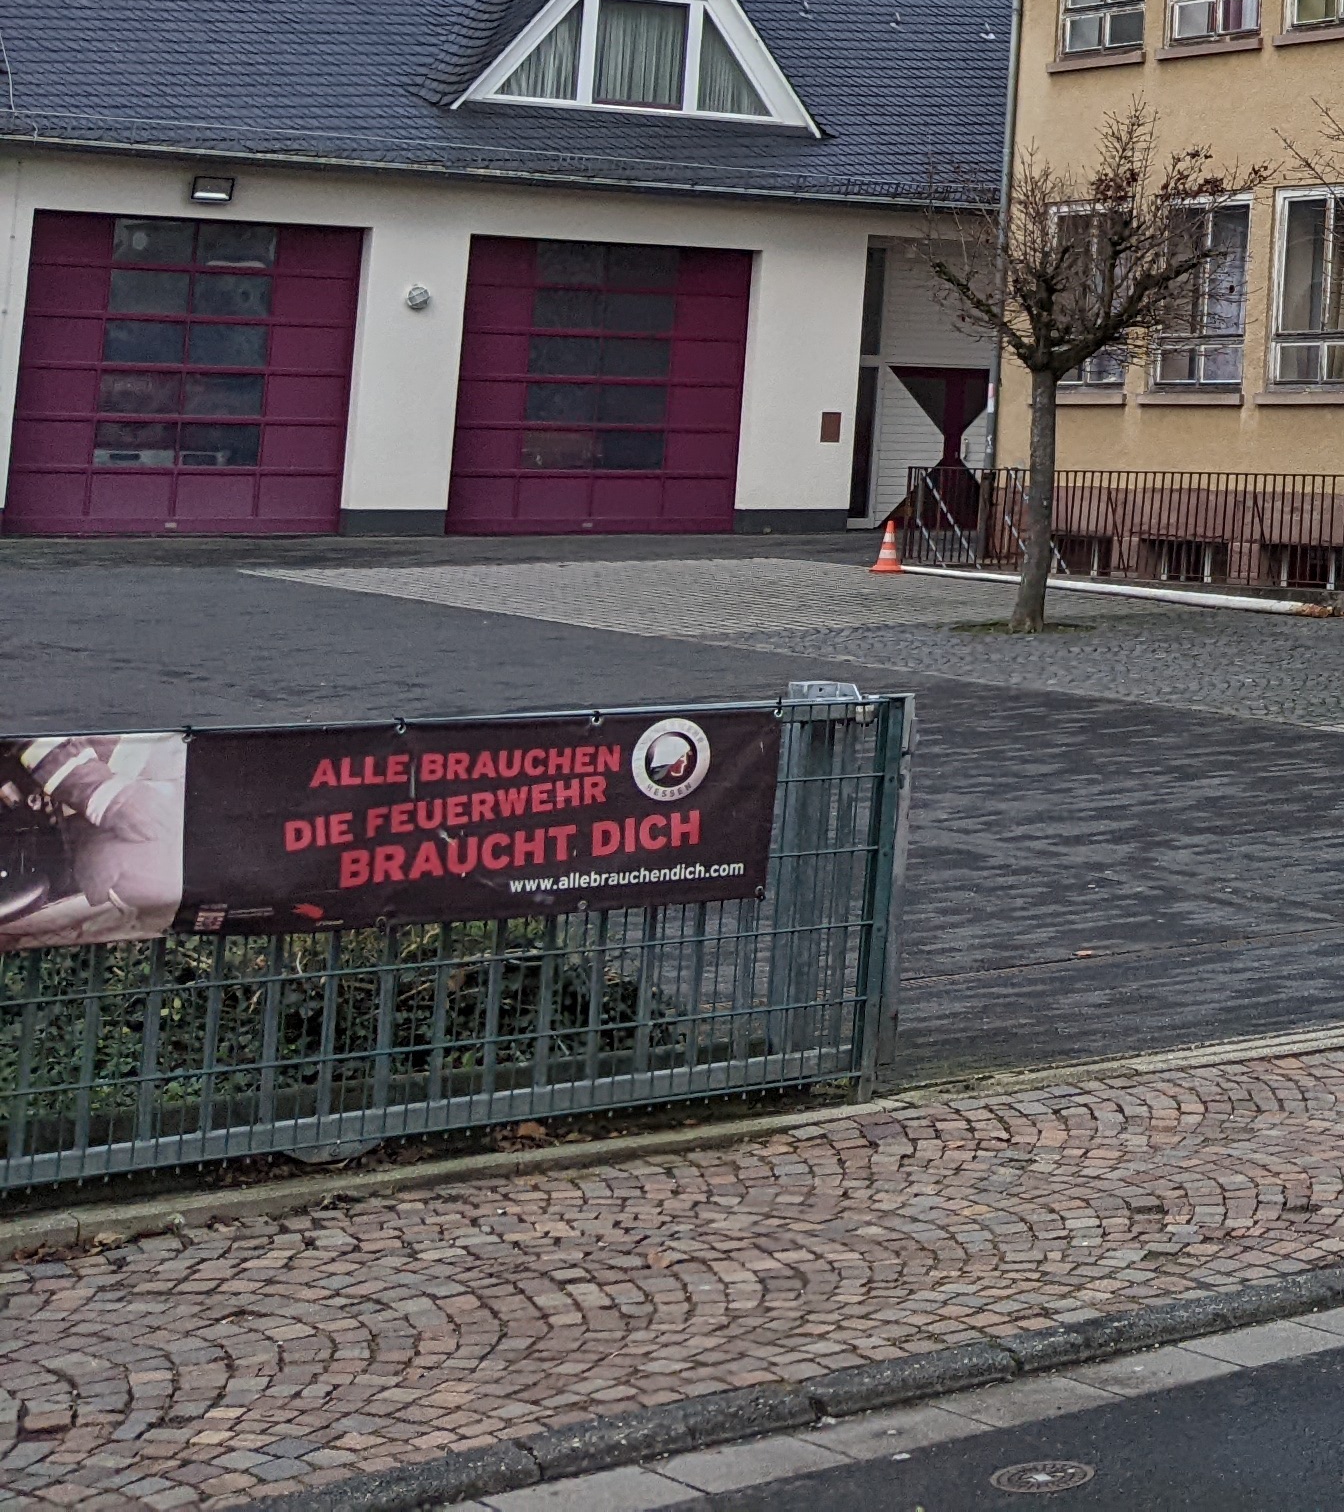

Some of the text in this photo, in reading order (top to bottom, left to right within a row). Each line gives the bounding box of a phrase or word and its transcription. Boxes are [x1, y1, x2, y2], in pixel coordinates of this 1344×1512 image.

[309, 754, 409, 788] ALLE
[420, 745, 621, 781] BRAUCHEN
[647, 782, 692, 798] HESSEN
[284, 776, 608, 853] DIE FEUERWEHR
[340, 809, 702, 888] BRAUCHT DICH
[510, 860, 745, 894] www.allebrauchendich.com
